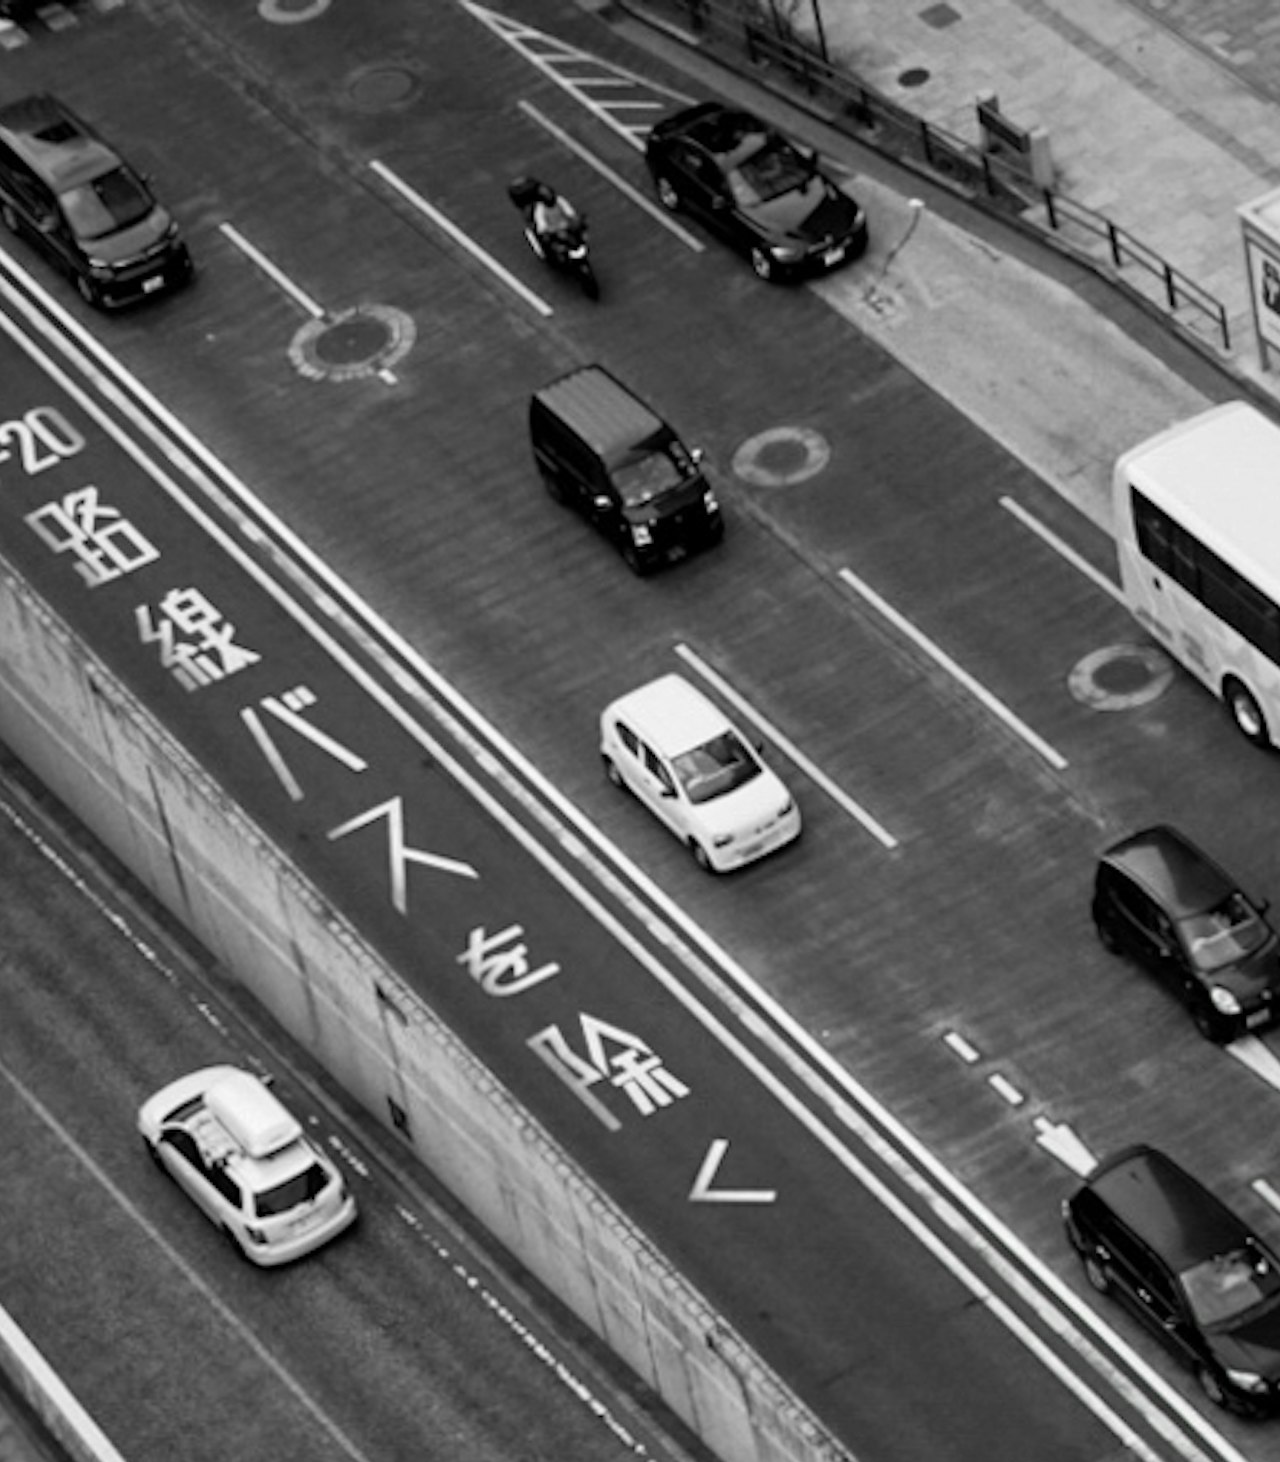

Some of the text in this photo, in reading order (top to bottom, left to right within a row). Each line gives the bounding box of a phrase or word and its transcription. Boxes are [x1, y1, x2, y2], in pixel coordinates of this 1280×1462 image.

[24, 484, 778, 1203] 路線バスを除く
